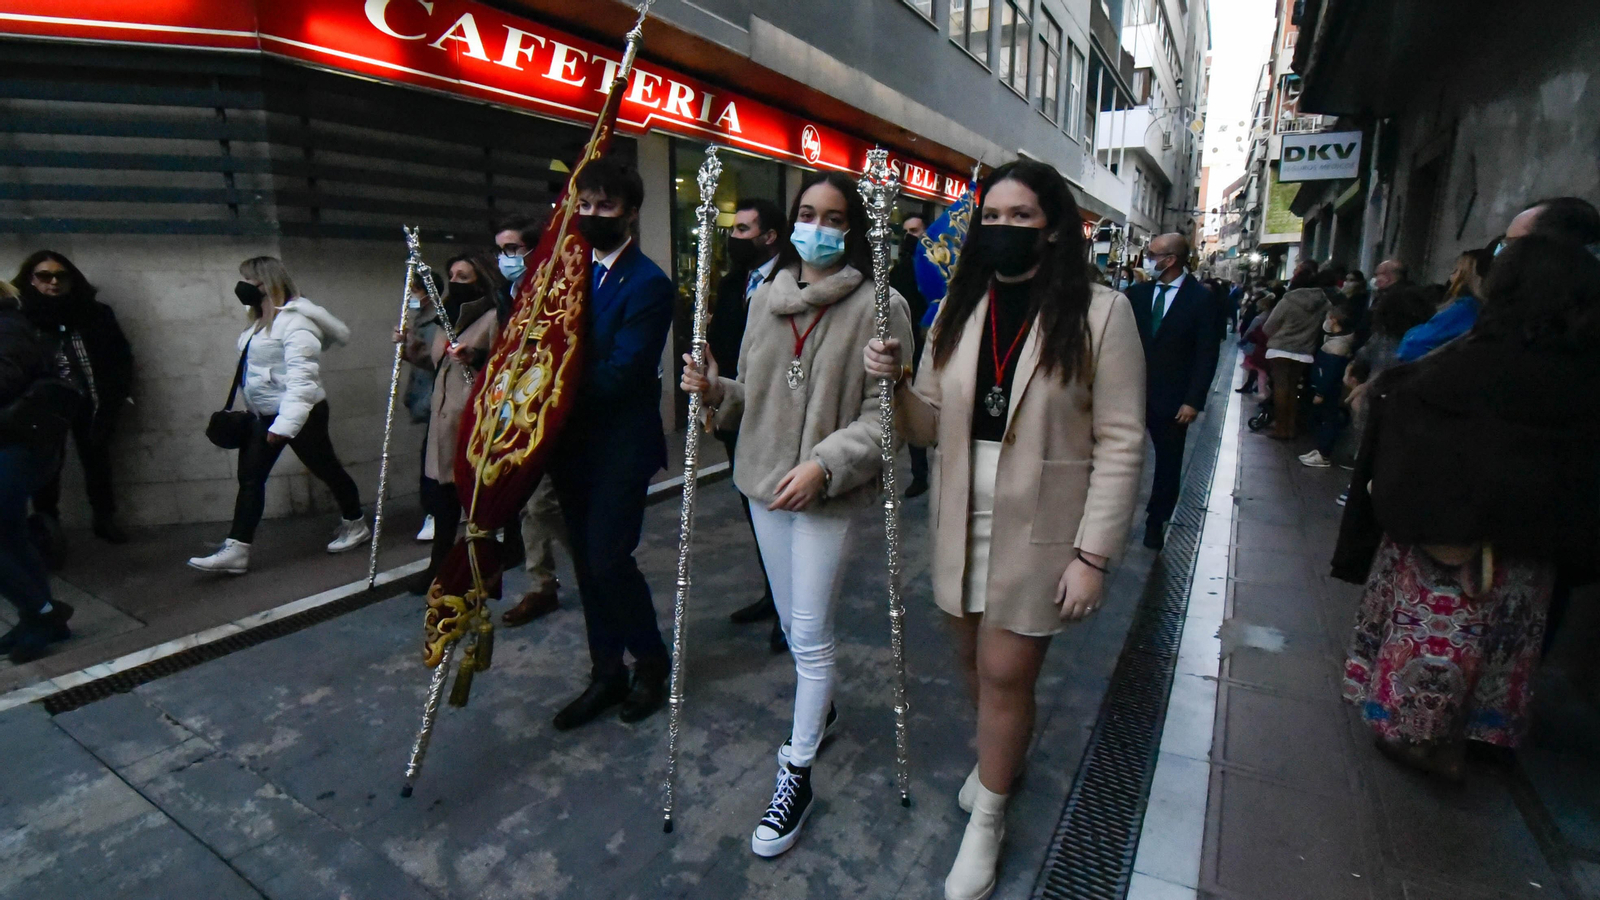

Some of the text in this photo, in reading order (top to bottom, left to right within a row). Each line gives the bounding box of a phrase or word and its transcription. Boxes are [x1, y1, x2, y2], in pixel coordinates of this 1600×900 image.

[364, 0, 742, 134] CAFETERIA
[1284, 142, 1357, 162] DKV
[863, 157, 968, 198] STELERIA
